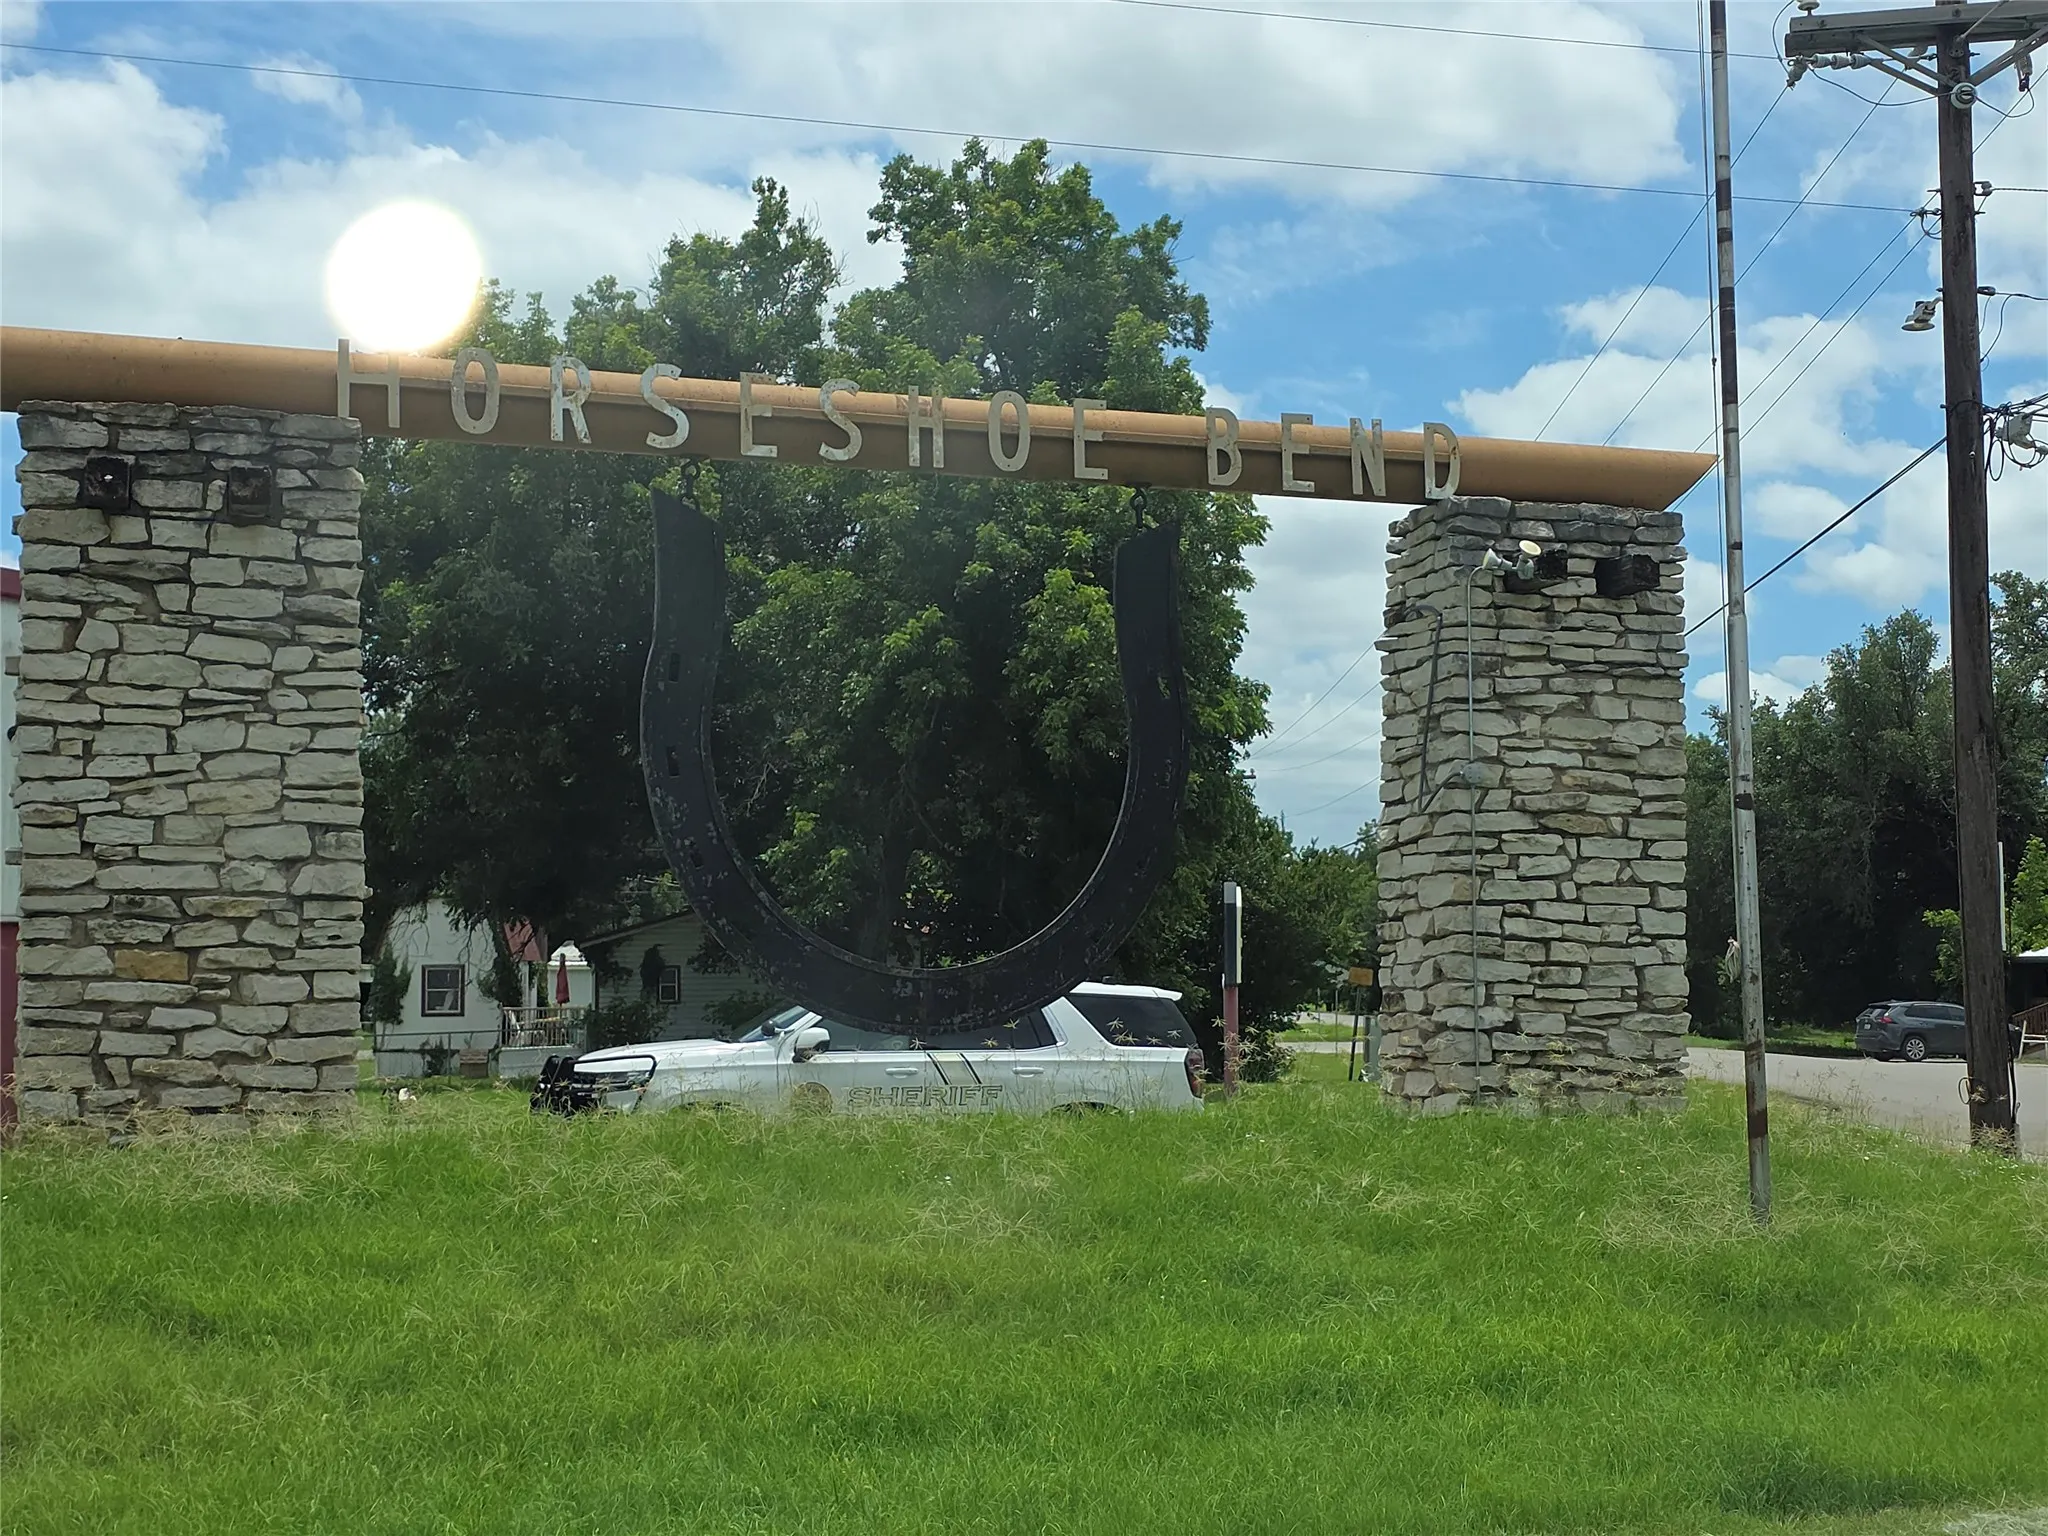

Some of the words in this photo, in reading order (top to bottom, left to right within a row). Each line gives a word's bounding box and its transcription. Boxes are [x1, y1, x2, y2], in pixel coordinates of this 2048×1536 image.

[338, 338, 1108, 481] HORSESHOE
[1205, 407, 1461, 499] BEND
[848, 1085, 1003, 1107] SHERIFF
